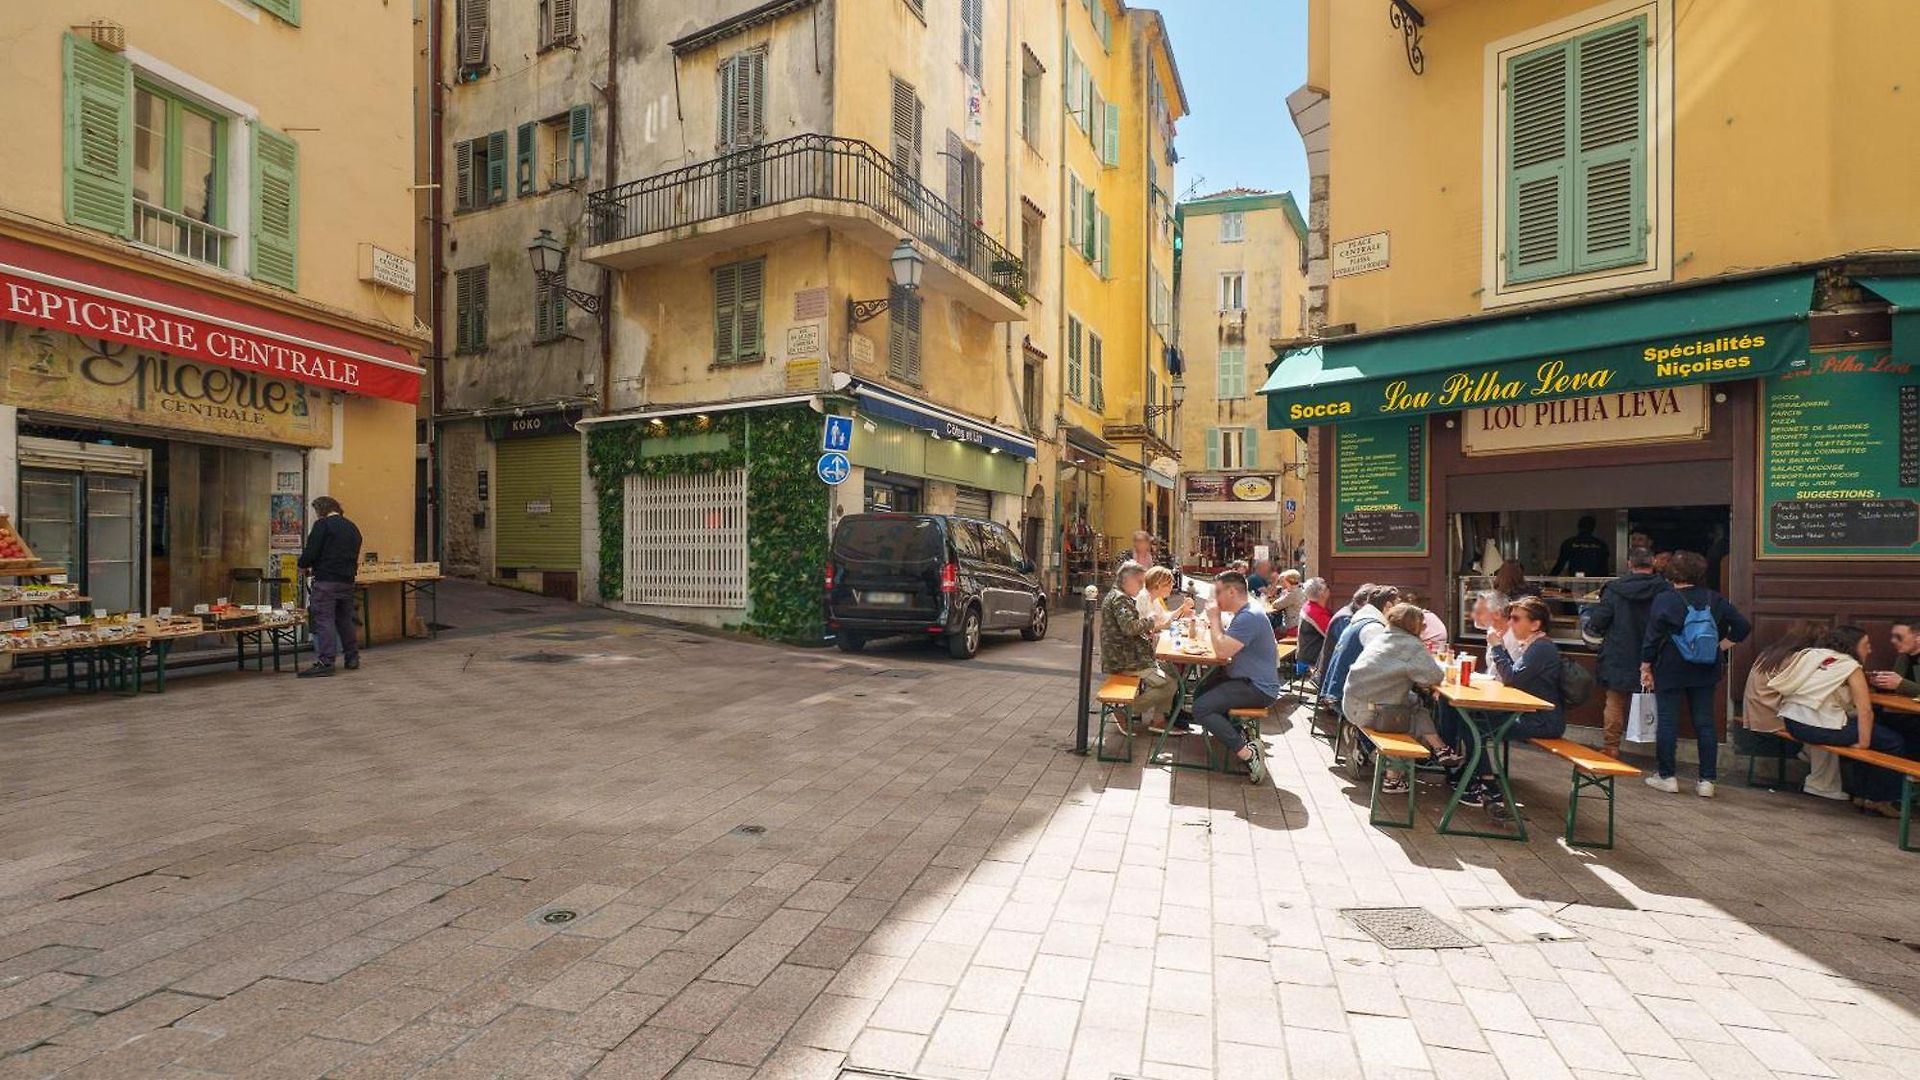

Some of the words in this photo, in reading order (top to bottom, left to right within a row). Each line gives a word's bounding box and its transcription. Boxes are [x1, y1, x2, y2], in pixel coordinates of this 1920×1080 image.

[6, 283, 198, 351] EPICERIE
[206, 332, 359, 386] CENTRALE
[1644, 334, 1766, 362] Spécialités
[1657, 356, 1751, 377] Niçoises
[1379, 380, 1434, 413] Lou
[1439, 370, 1528, 405] Pilha
[1530, 360, 1617, 396] Leva
[161, 399, 265, 424] CENTRALE
[1290, 400, 1352, 420] Socca
[1482, 404, 1528, 431] LOU
[1535, 395, 1609, 427] PILHA
[1615, 388, 1681, 420] LEVA
[512, 418, 541, 431] KOKO
